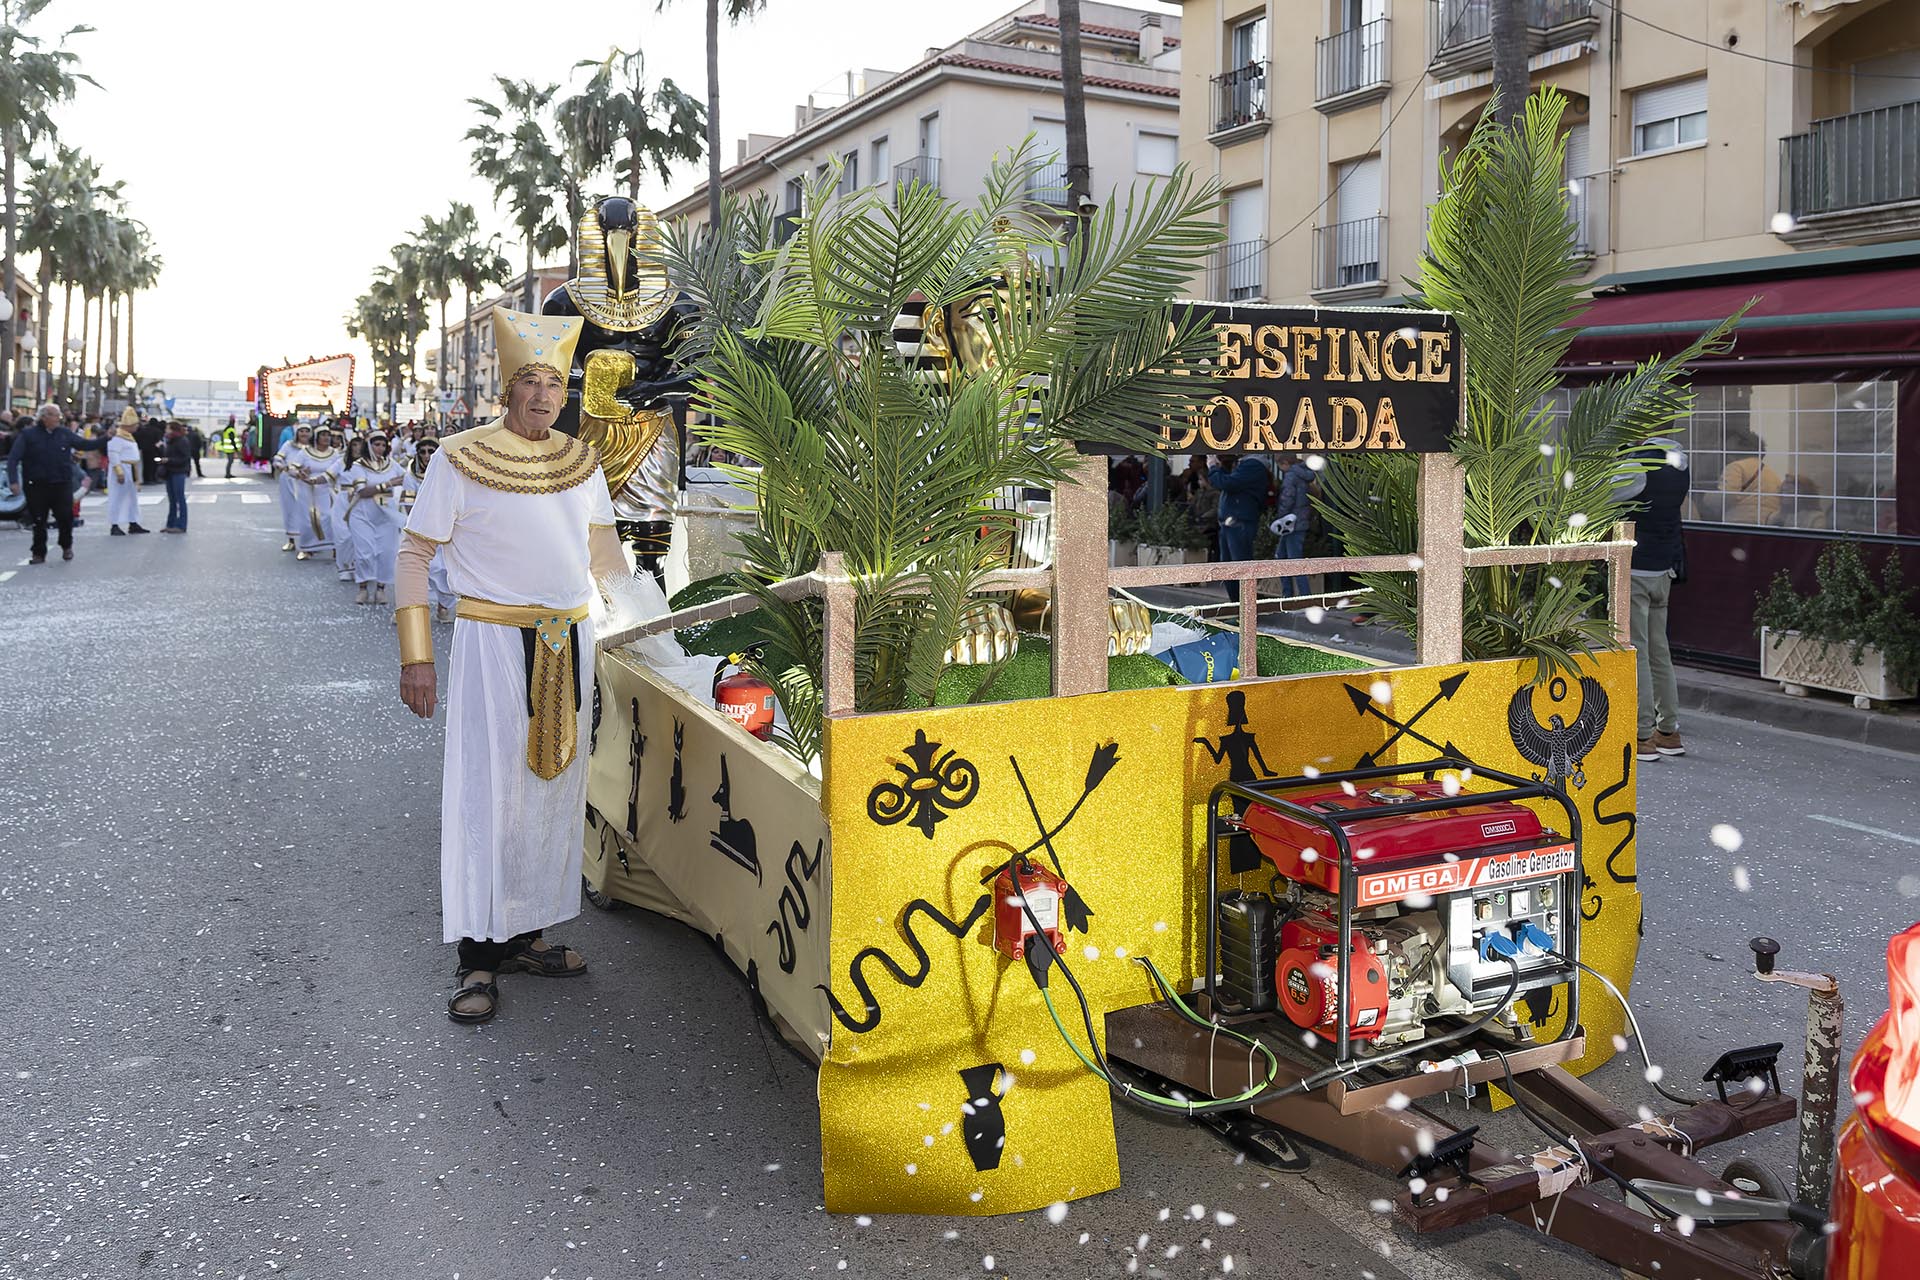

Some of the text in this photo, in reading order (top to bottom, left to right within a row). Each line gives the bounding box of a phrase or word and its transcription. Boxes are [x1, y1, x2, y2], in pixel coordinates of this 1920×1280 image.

[1157, 394, 1408, 453] DORADA
[1488, 849, 1573, 880] Gasoline Generator
[1369, 868, 1455, 896] OMEGA
